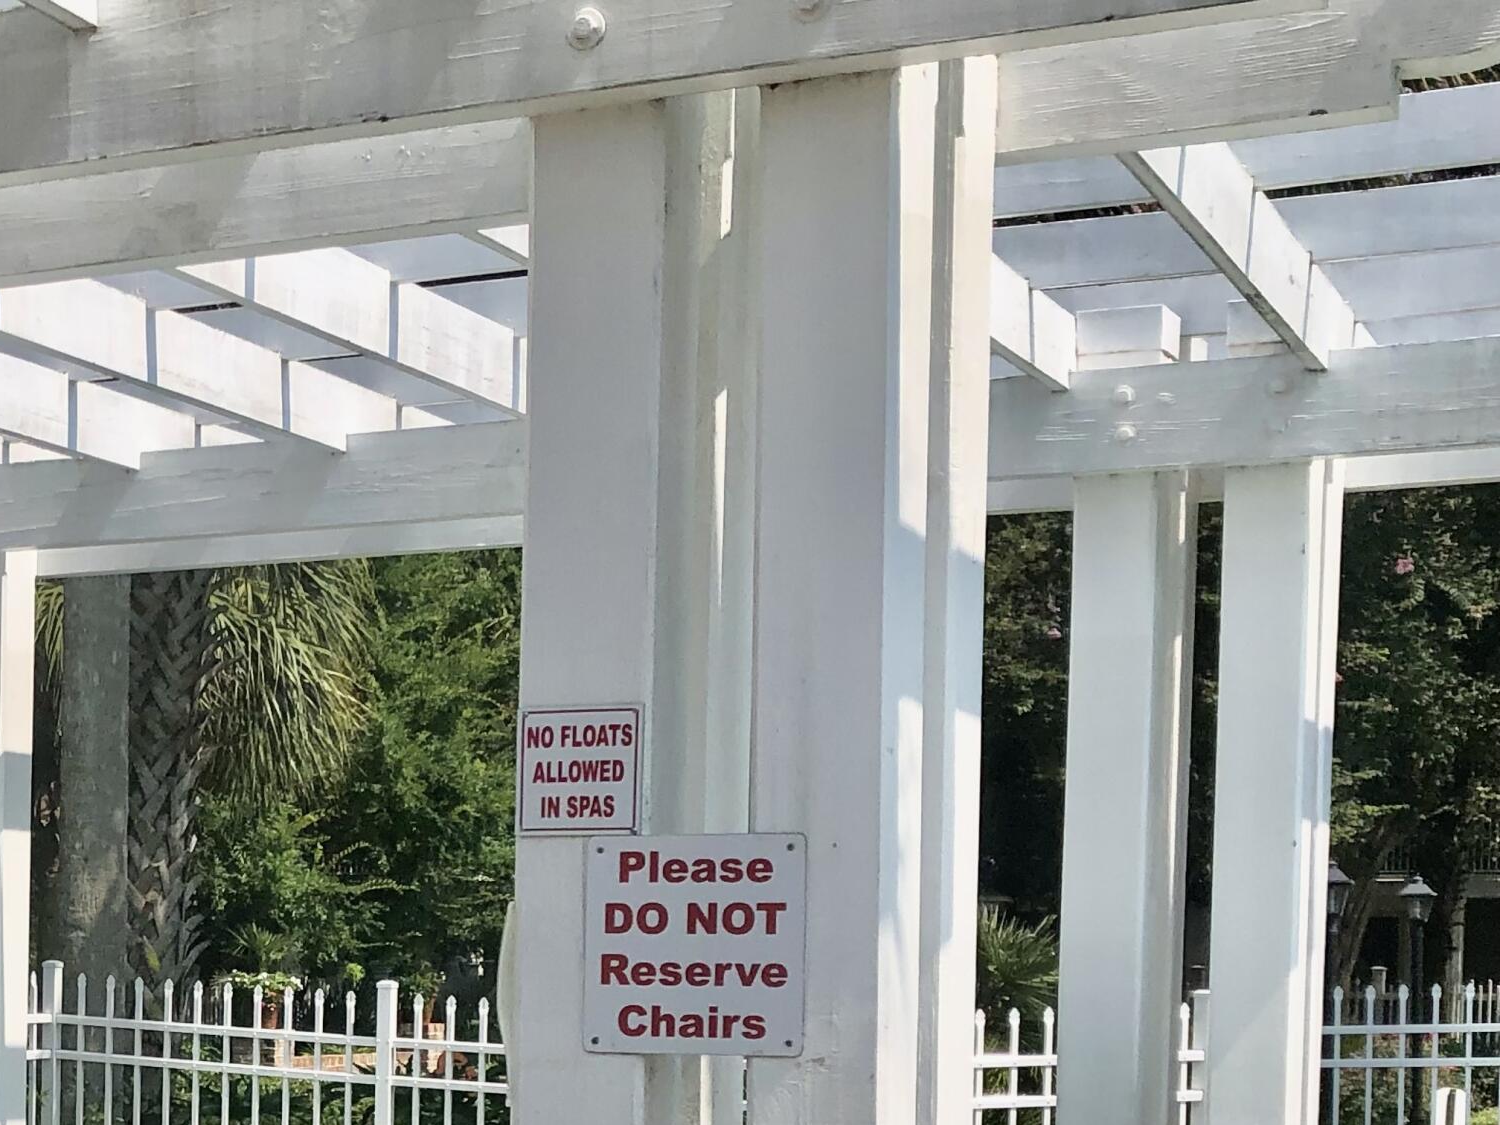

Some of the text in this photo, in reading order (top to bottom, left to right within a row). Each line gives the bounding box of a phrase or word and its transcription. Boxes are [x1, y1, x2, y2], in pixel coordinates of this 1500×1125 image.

[527, 724, 632, 748] NO FLOATS
[533, 759, 624, 783] ALLOWED
[541, 795, 614, 818] IN SPAS
[619, 851, 773, 883] Please
[605, 902, 787, 935] DO NOT
[601, 954, 788, 988] Reserve
[618, 1005, 766, 1039] Chairs
